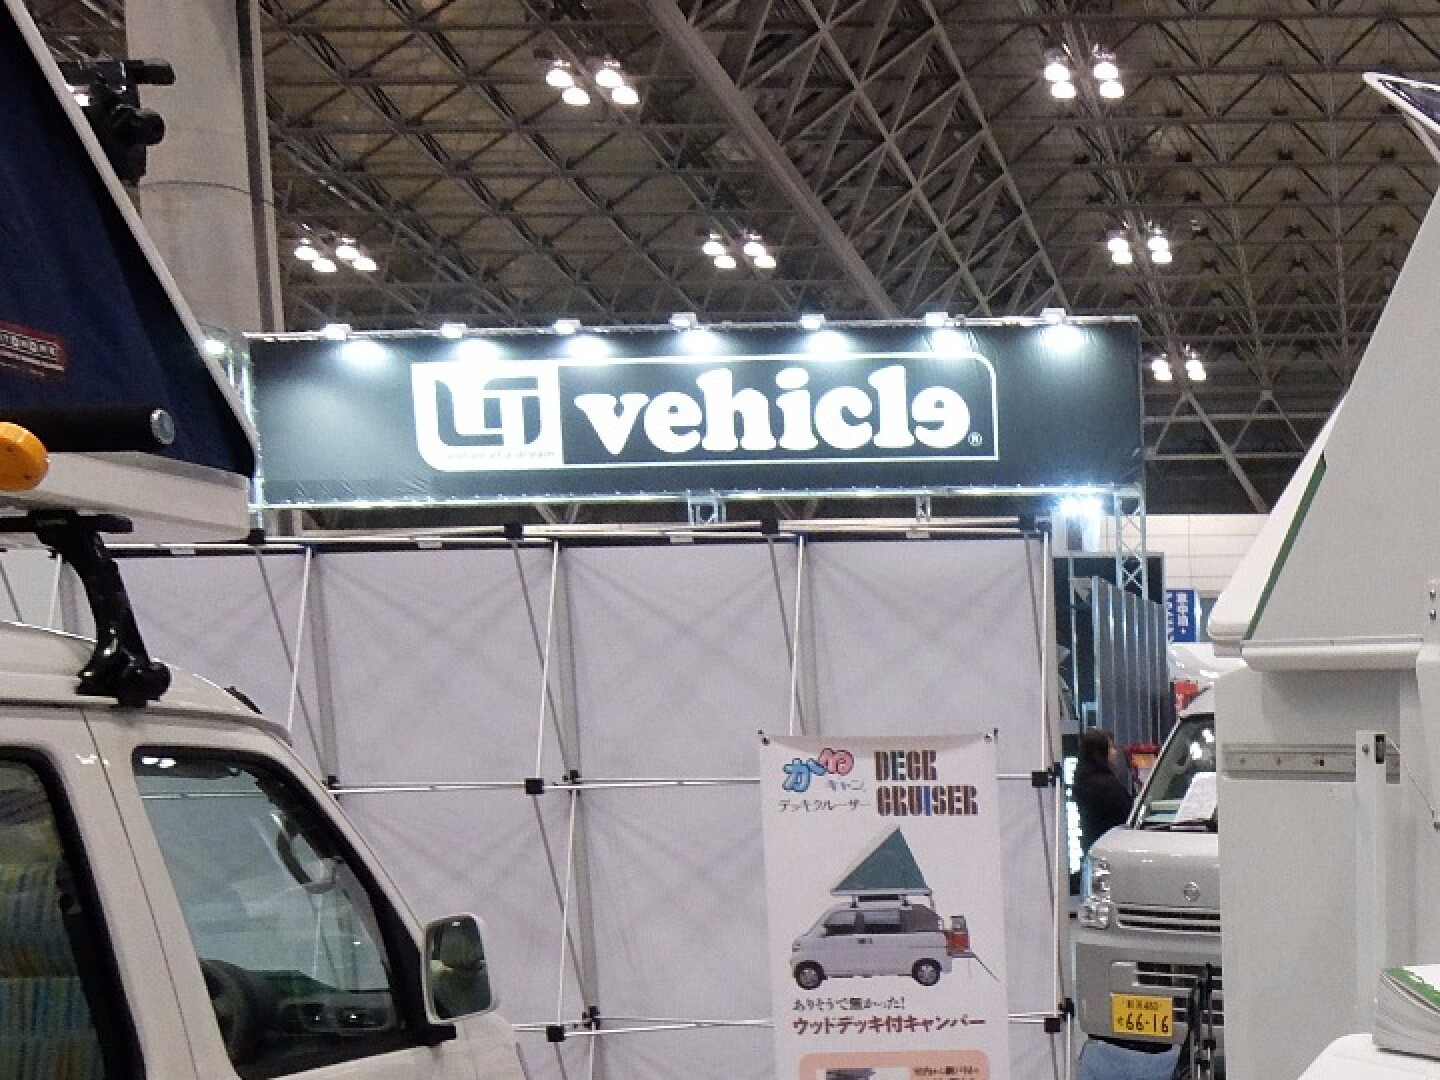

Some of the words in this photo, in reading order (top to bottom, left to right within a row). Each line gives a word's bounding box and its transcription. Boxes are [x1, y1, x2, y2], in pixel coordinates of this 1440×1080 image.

[573, 365, 971, 456] vehicle
[874, 749, 938, 781] DECK
[875, 785, 979, 816] CRUISER
